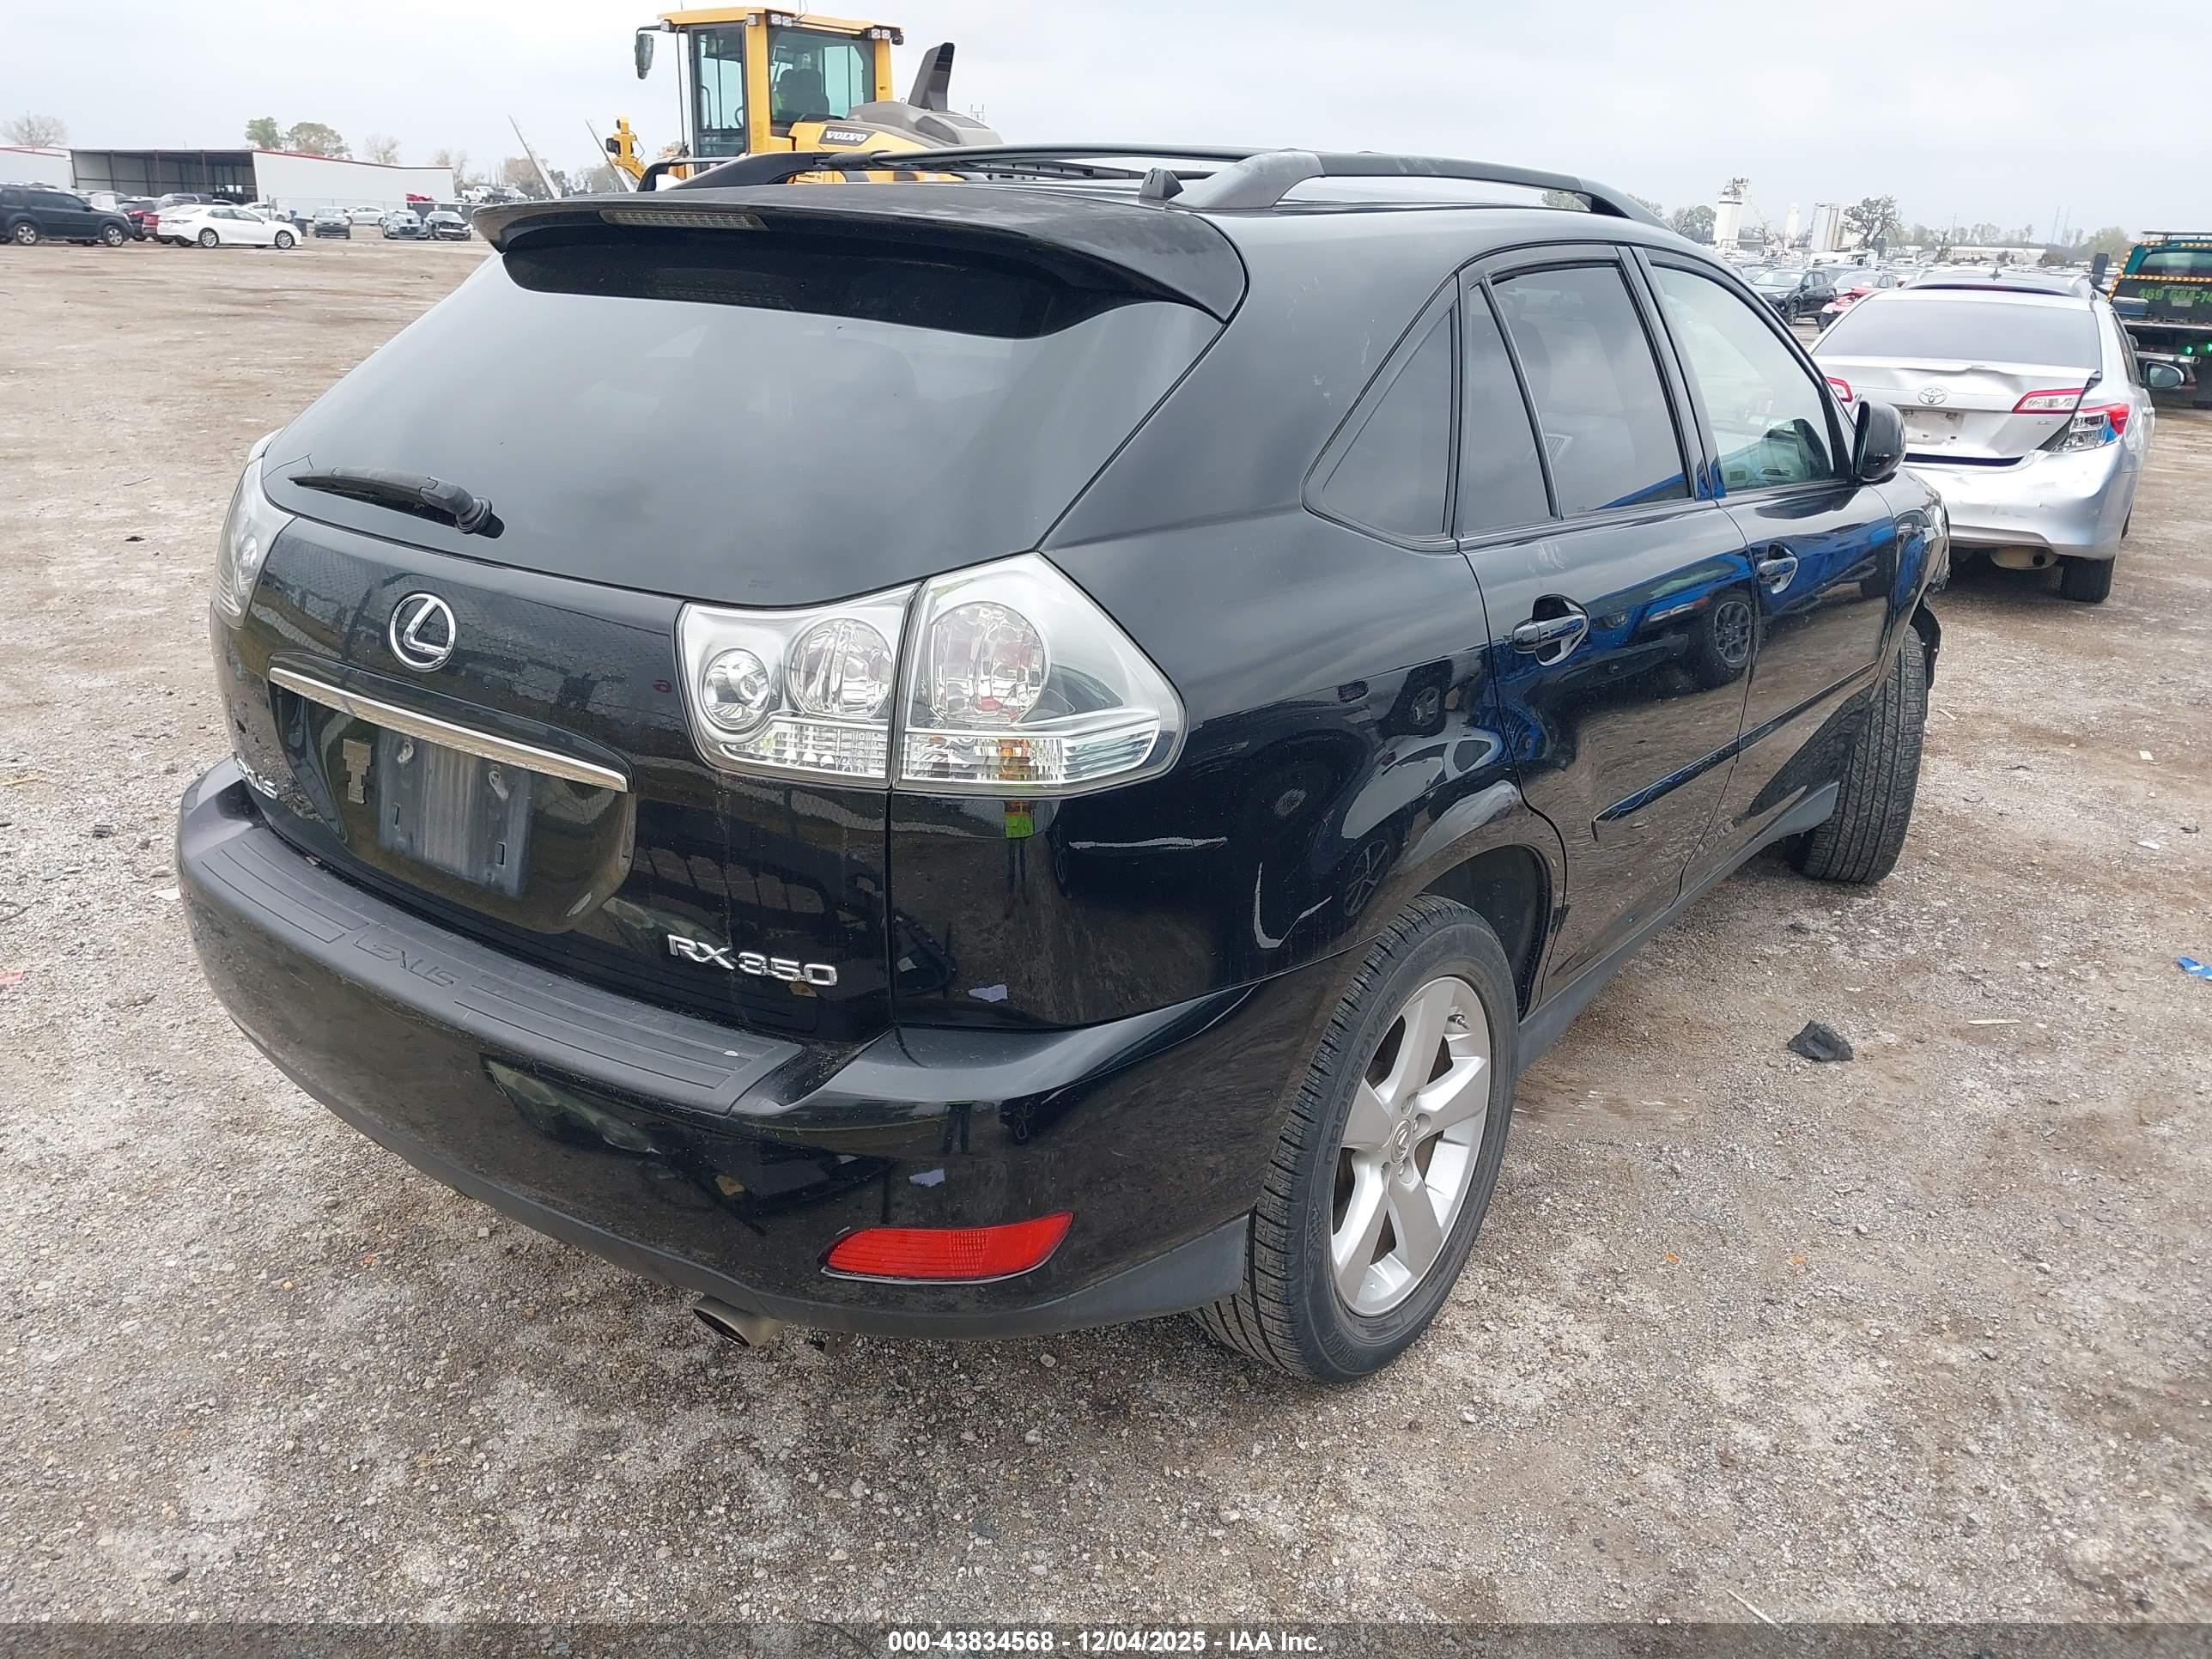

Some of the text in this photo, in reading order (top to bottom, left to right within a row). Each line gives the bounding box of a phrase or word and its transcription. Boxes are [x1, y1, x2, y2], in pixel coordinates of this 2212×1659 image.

[825, 130, 868, 143] VOLVO
[352, 933, 462, 988] LEXUS
[666, 933, 838, 987] RX 350
[1325, 990, 1398, 1165] CROSSOVER
